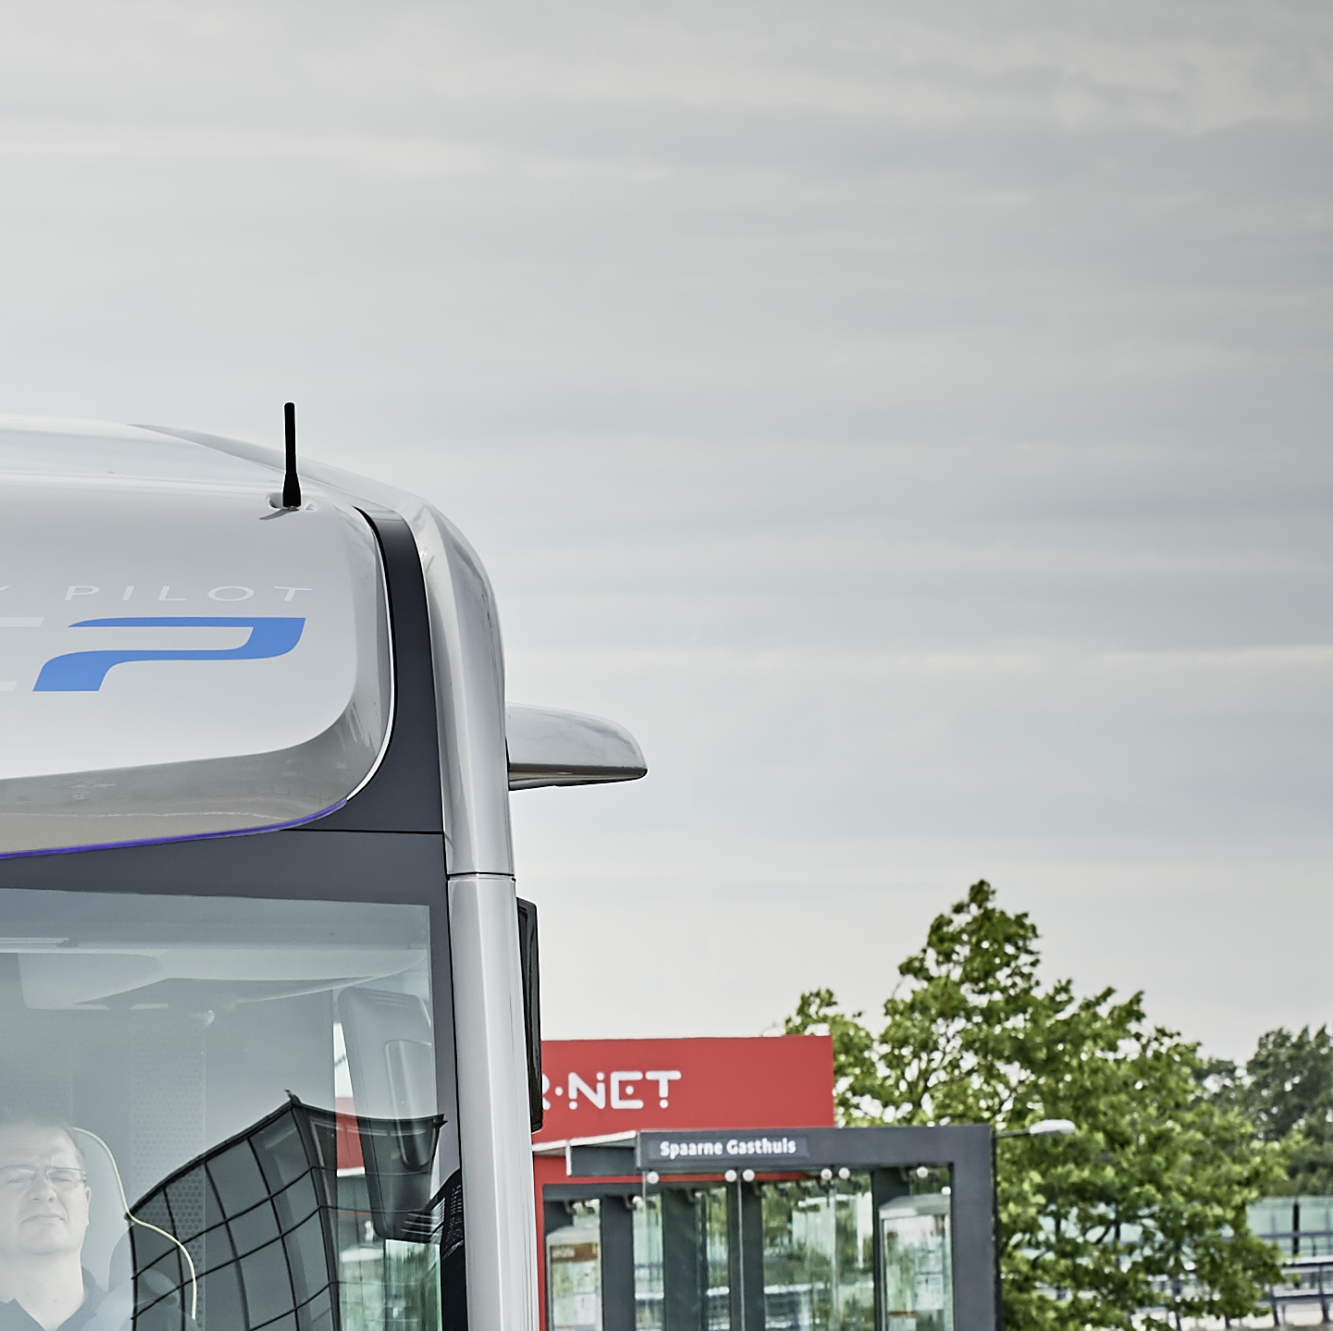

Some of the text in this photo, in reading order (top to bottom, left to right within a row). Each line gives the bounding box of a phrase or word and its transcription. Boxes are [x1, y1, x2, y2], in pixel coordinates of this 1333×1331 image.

[63, 584, 314, 602] PILOT
[660, 1138, 797, 1160] Spaarne Gasthuis
